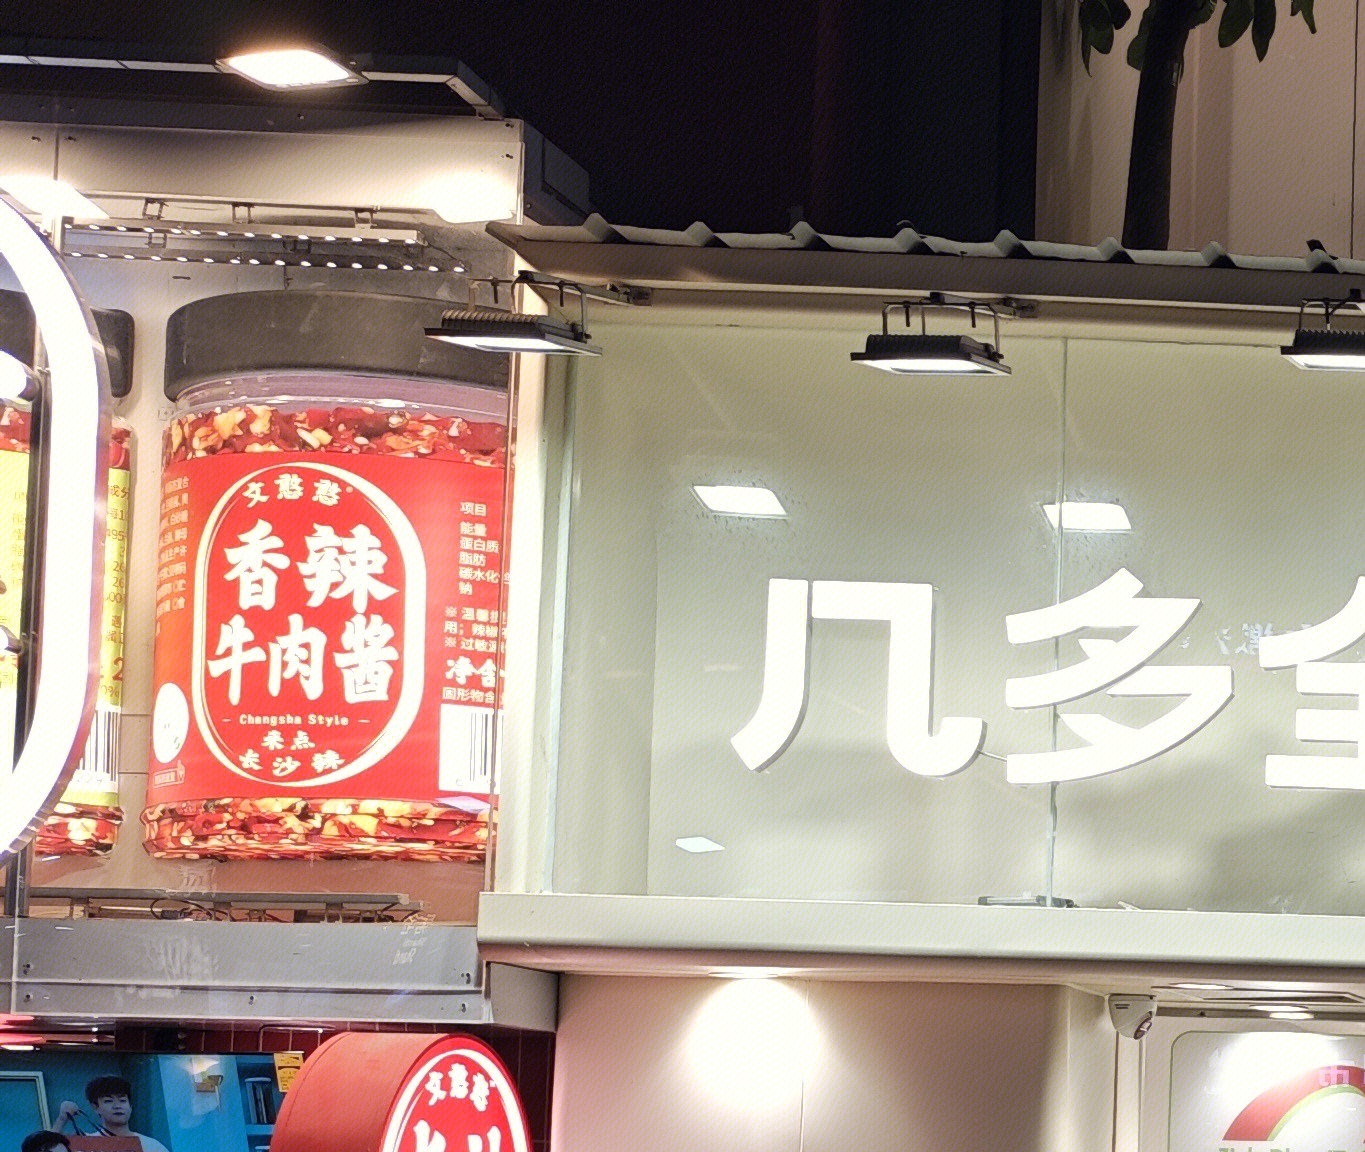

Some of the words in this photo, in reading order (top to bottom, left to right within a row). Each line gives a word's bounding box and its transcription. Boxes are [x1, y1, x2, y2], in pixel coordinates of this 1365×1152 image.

[459, 501, 488, 517] 项目
[459, 521, 488, 538] 能量
[223, 517, 401, 614] 香辣
[206, 612, 400, 707] 牛肉酱
[307, 714, 349, 728] Style
